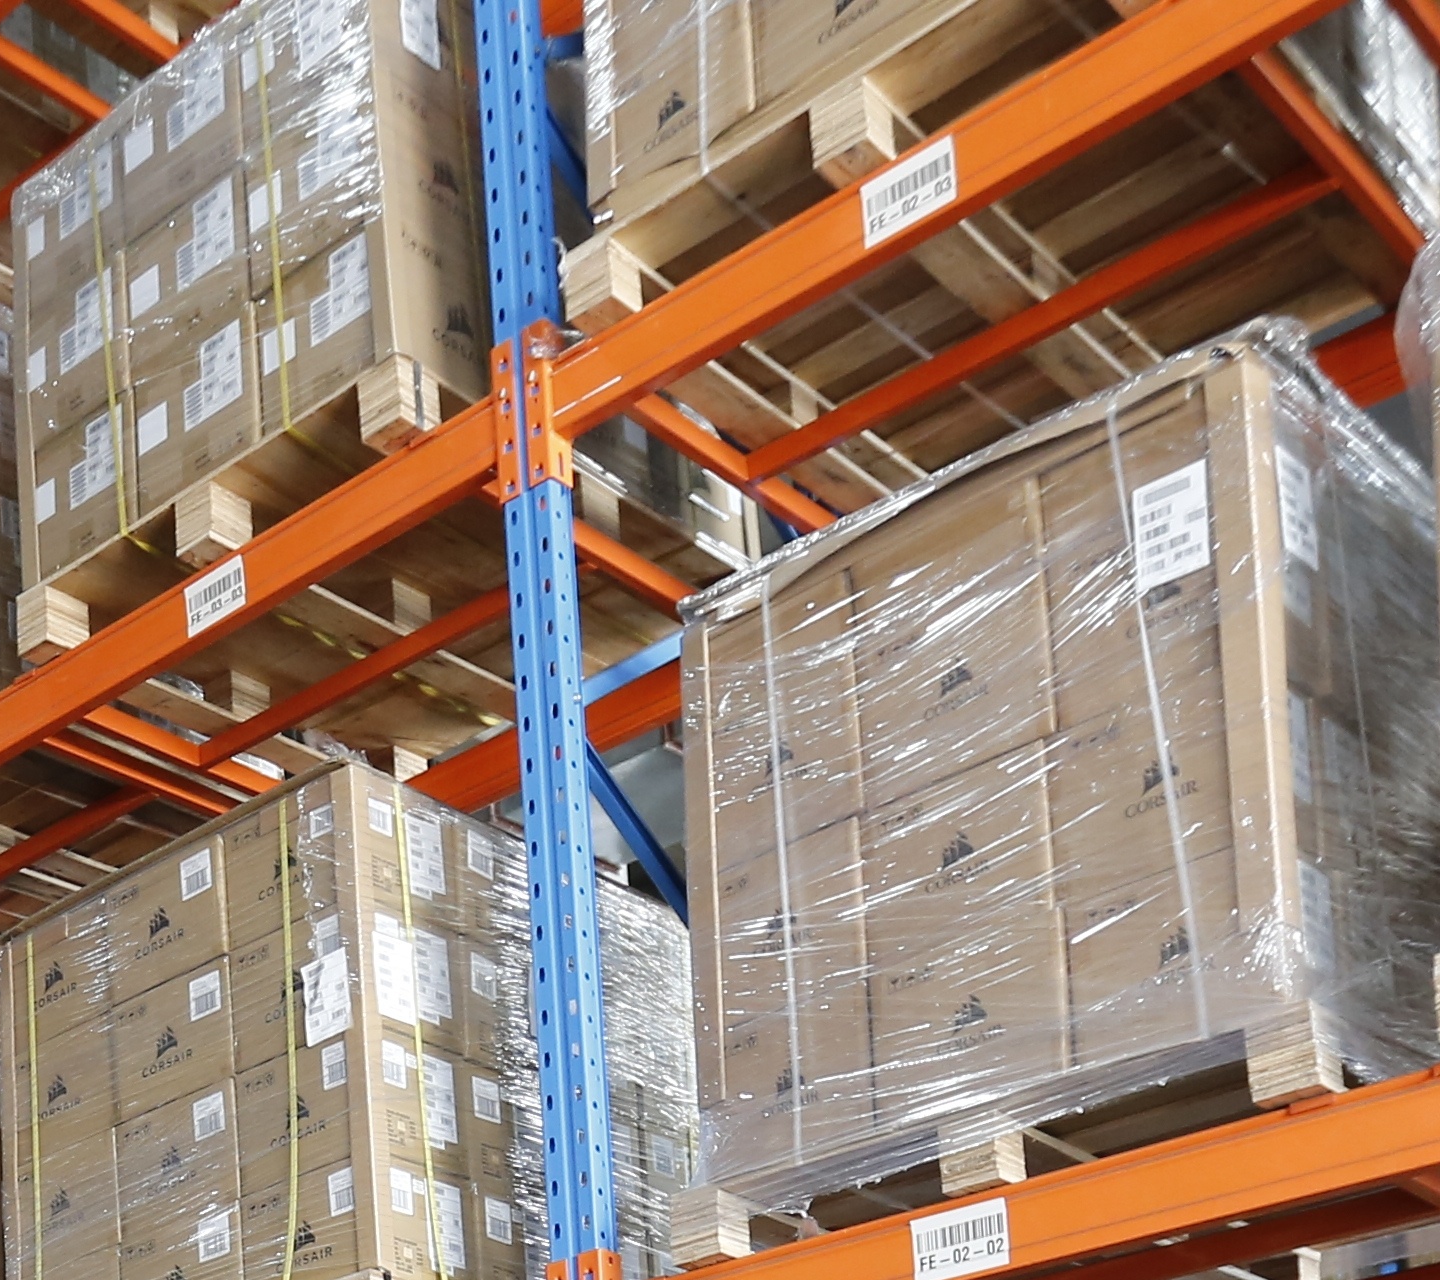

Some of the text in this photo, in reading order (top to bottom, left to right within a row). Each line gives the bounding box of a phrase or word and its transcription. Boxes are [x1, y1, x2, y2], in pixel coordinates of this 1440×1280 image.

[870, 176, 952, 235] FE-02-03
[190, 586, 242, 626] FE-03-03
[135, 928, 184, 961] CORSAIR
[142, 1048, 194, 1079] CORSAIR
[919, 1237, 1005, 1273] FE-02-02
